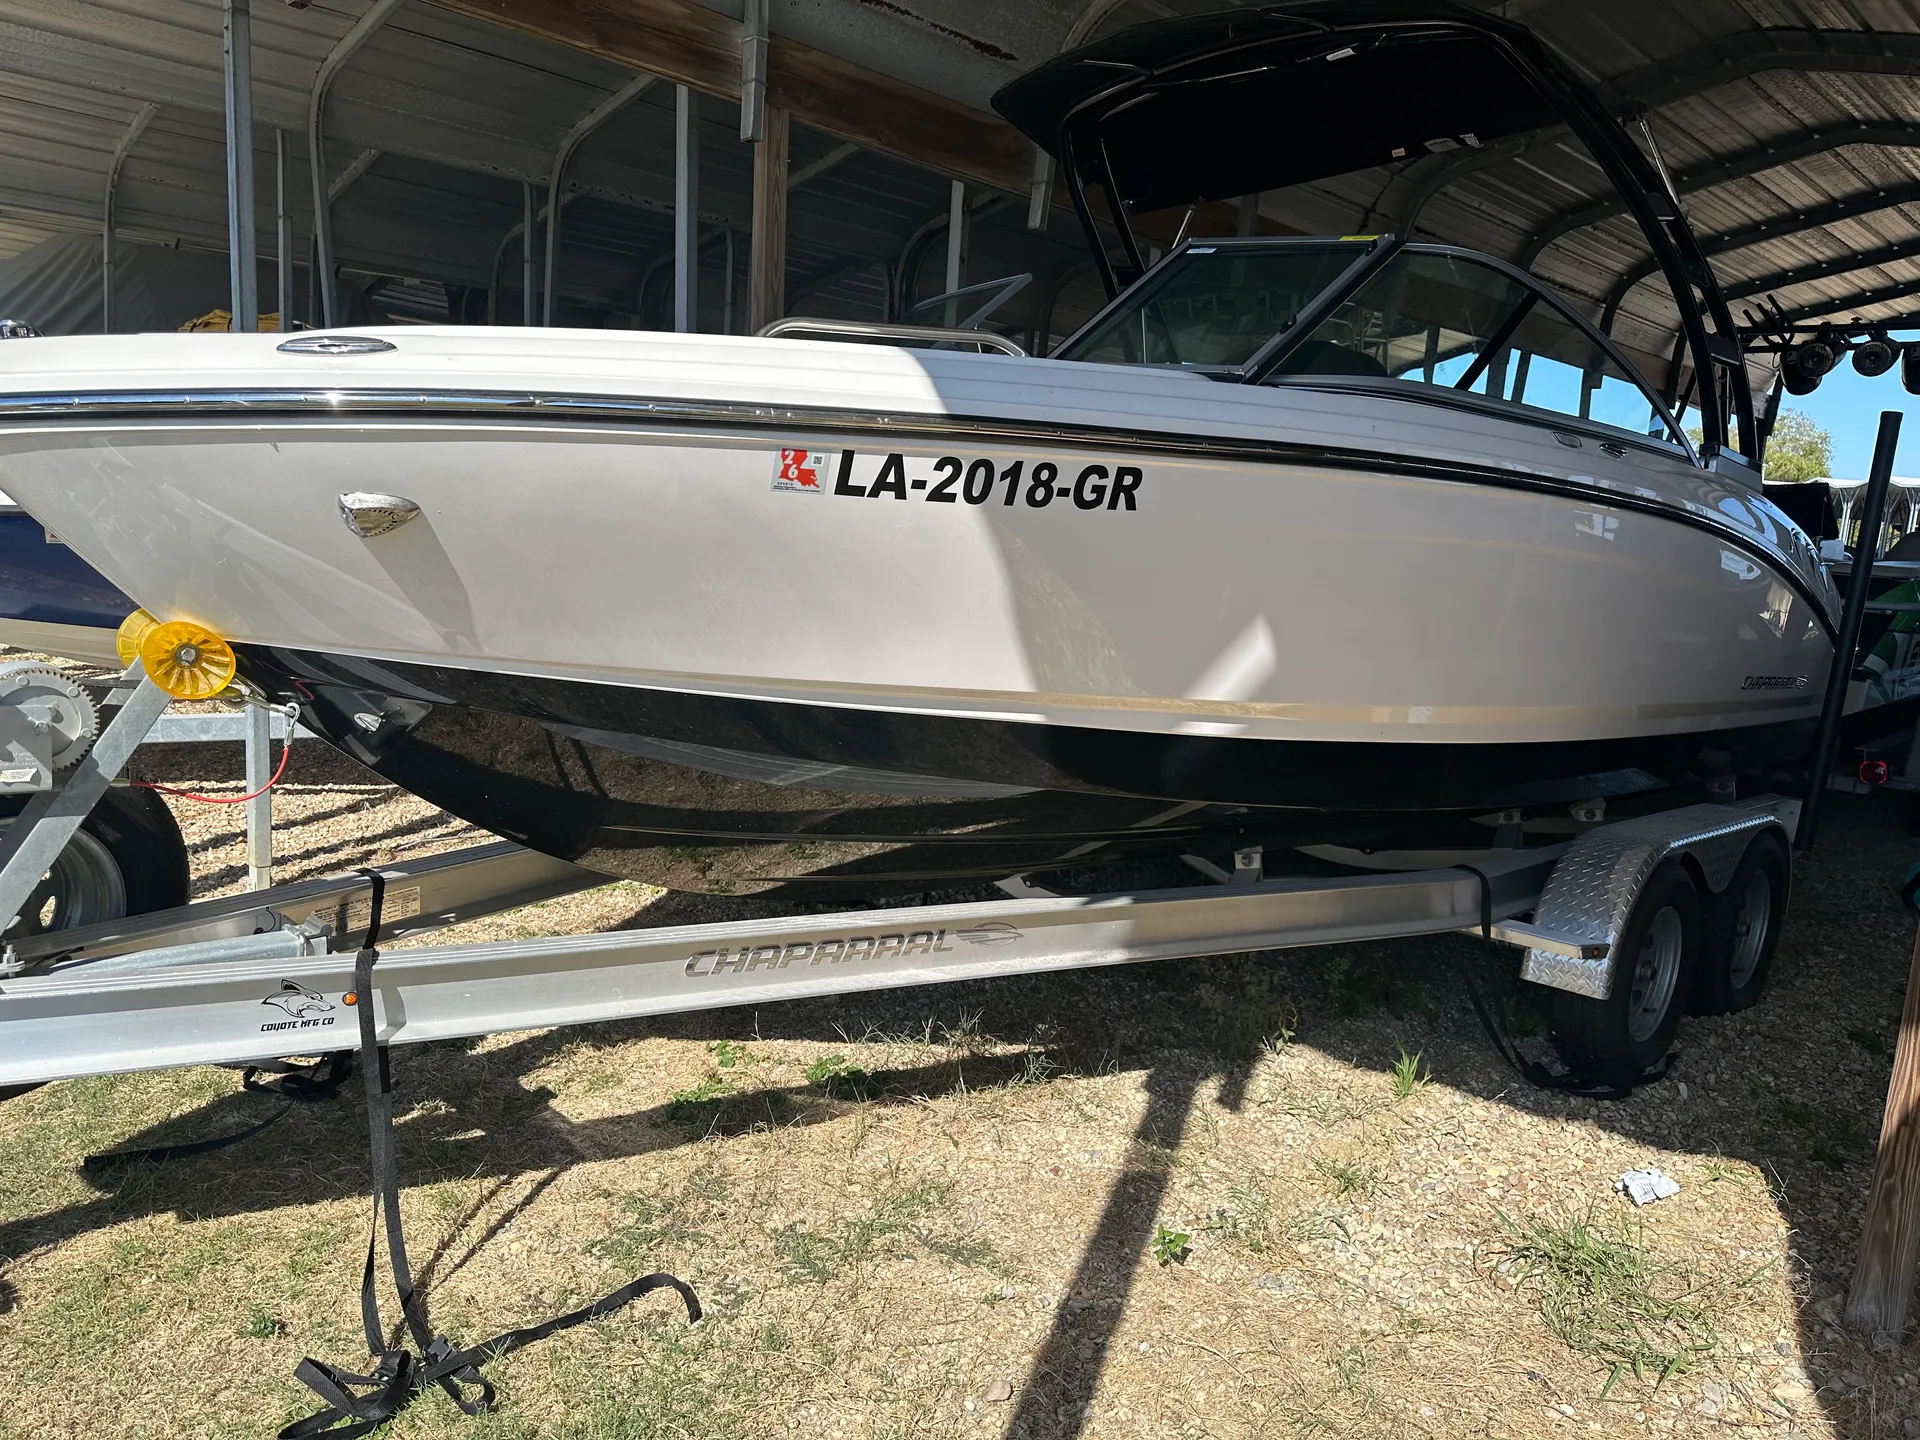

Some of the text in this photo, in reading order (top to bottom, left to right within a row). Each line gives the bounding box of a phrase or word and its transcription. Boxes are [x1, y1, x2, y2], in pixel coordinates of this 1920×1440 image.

[783, 449, 795, 464] 2
[788, 464, 798, 479] 6
[834, 449, 1143, 511] LA-2018-GR
[684, 928, 953, 977] CHAPARRAL
[261, 1017, 335, 1032] COYOTE MFG CO
